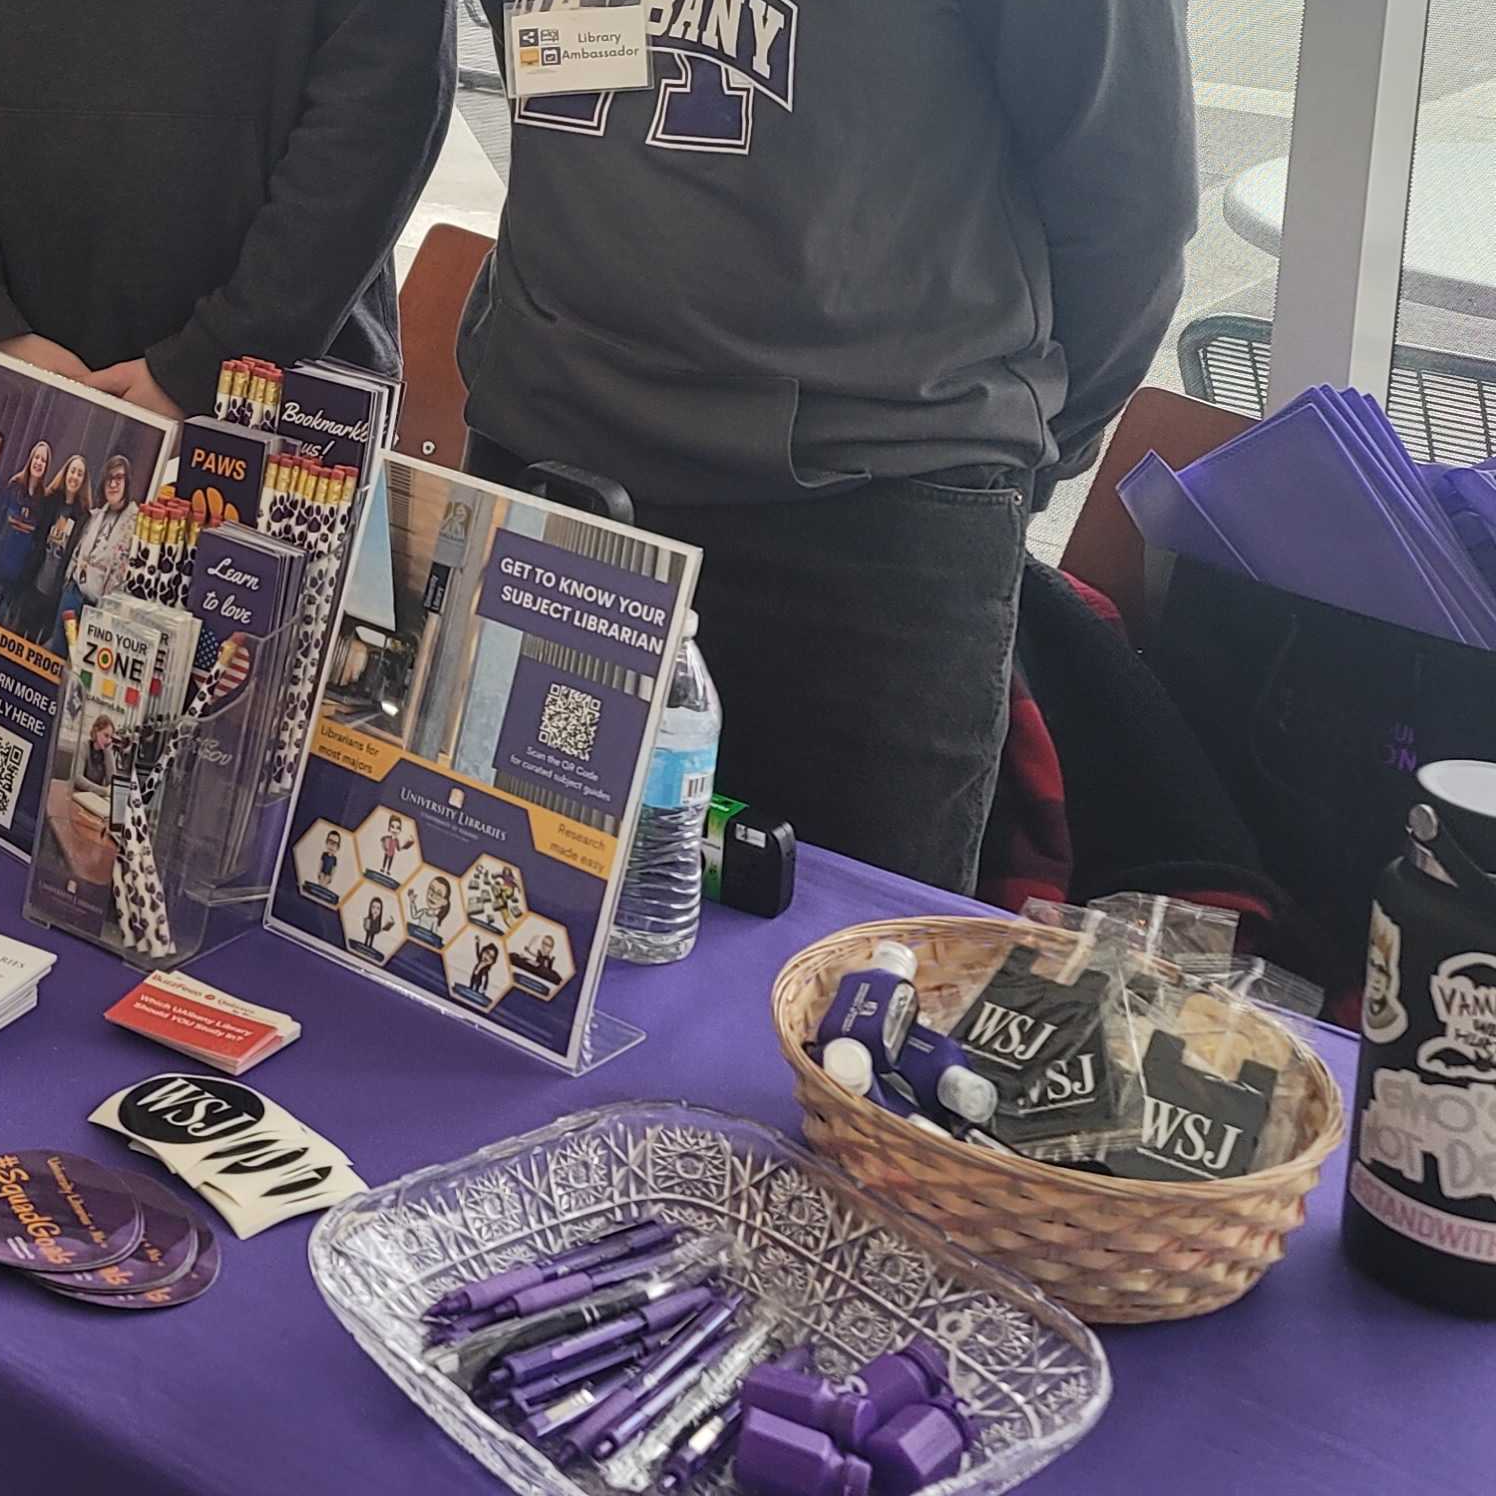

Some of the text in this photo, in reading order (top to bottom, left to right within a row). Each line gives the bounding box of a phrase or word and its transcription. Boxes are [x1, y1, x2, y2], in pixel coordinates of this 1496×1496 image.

[562, 45, 640, 60] Ambassador
[577, 31, 622, 45] Library
[191, 447, 247, 481] PAWS
[207, 557, 260, 592] Learn
[500, 556, 667, 627] GET TO KNOW YOUR
[202, 591, 253, 625] to love
[501, 584, 664, 655] SUBJECT LIBRARIAN
[87, 623, 114, 643] FIND
[115, 633, 148, 656] YOUR
[83, 641, 145, 684] ZONE
[14, 681, 52, 711] MORE
[11, 707, 46, 737] HERE:
[319, 725, 380, 757] Librarians for
[317, 744, 374, 775] most majors
[400, 786, 457, 820] UNIVERSITY
[457, 811, 507, 842] LIBRARIES
[967, 1001, 1058, 1061] WSJ
[135, 1077, 258, 1138] WSJ
[1140, 1094, 1244, 1170] WSJ
